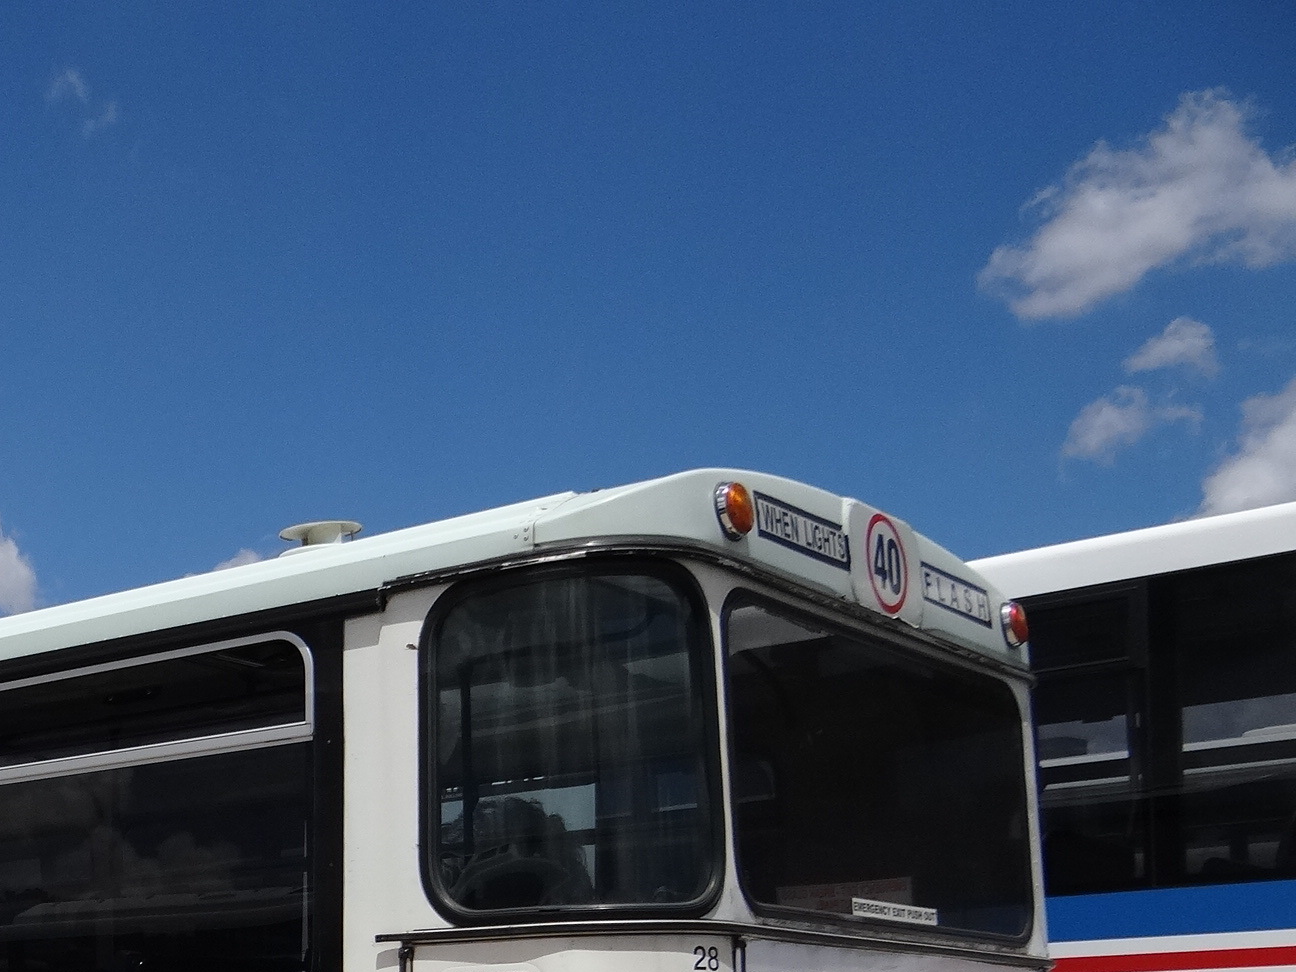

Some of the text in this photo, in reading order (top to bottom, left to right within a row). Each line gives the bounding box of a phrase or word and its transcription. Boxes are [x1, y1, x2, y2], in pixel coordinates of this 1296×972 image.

[760, 501, 846, 559] WHEN LIGHTS
[874, 533, 902, 596] 40
[853, 901, 936, 921] EMERGENCY EXIT PUSH OUT
[693, 945, 719, 972] 28
